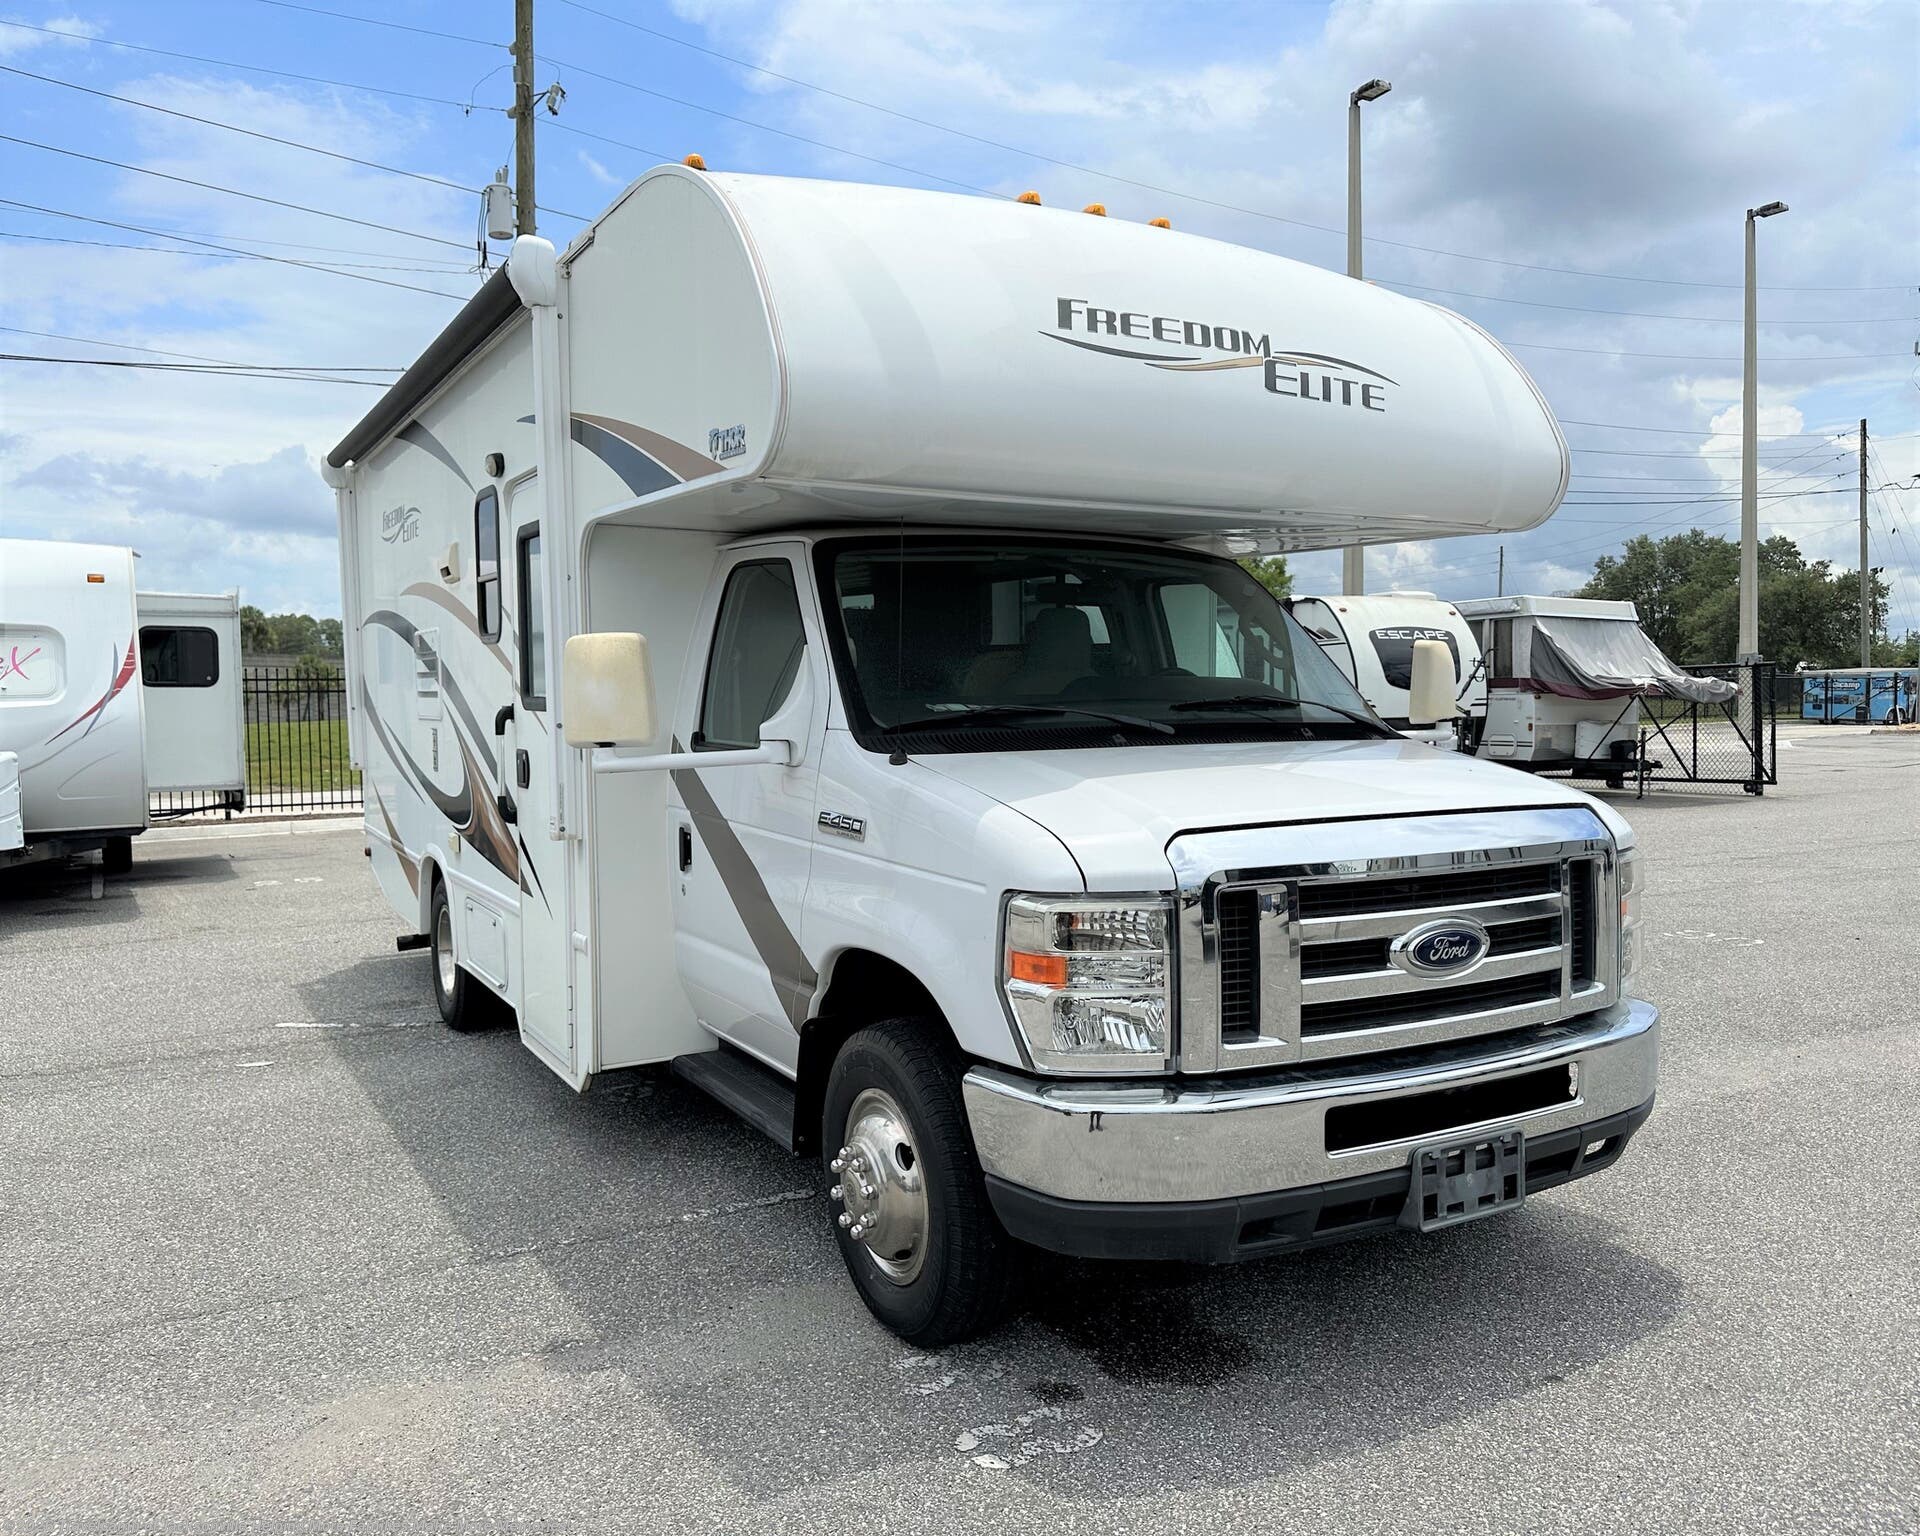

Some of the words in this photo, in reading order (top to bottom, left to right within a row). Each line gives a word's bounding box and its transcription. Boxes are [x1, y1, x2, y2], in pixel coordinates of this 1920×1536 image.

[1057, 296, 1271, 358] FREEDOM
[1265, 358, 1385, 412] ELITE
[1375, 630, 1449, 640] ESCAPE
[1429, 936, 1470, 961] Ford
